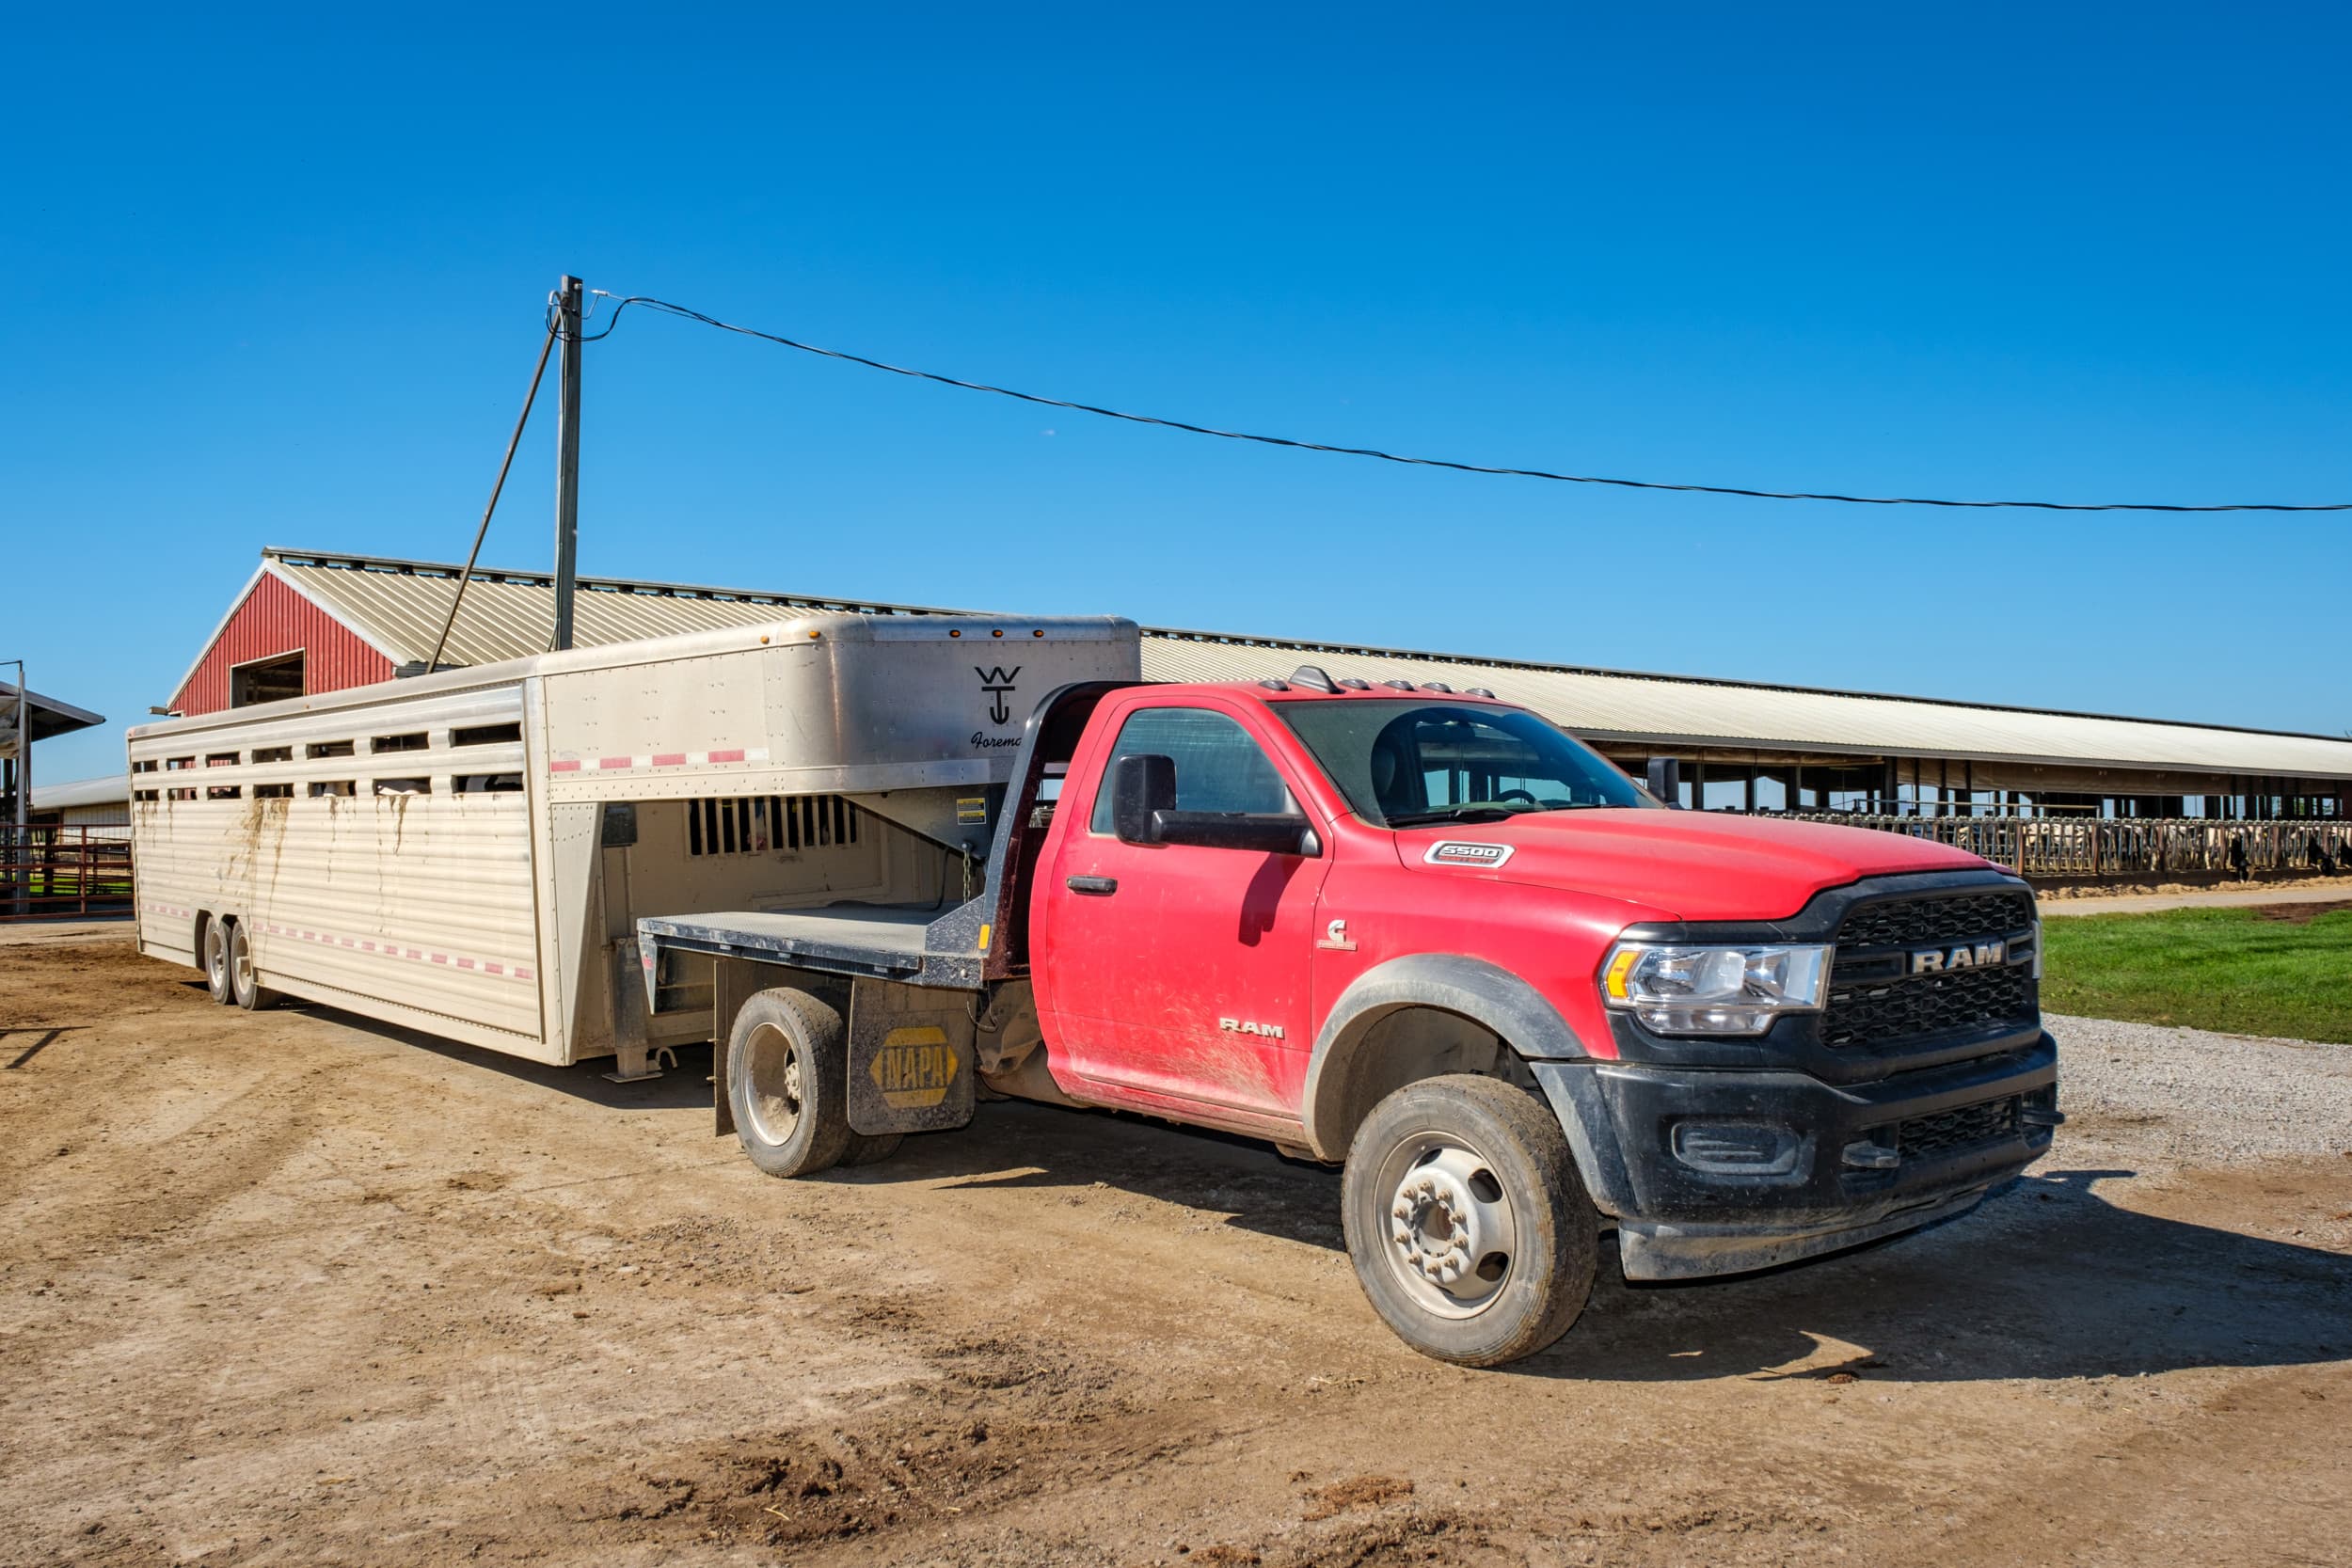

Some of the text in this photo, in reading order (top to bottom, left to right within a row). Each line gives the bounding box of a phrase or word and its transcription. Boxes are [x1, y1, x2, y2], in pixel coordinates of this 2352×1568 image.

[1442, 846, 1500, 858] 5500
[1912, 941, 2005, 974] RAM
[1218, 1017, 1285, 1039] RAM
[886, 1045, 945, 1090] NAPA
